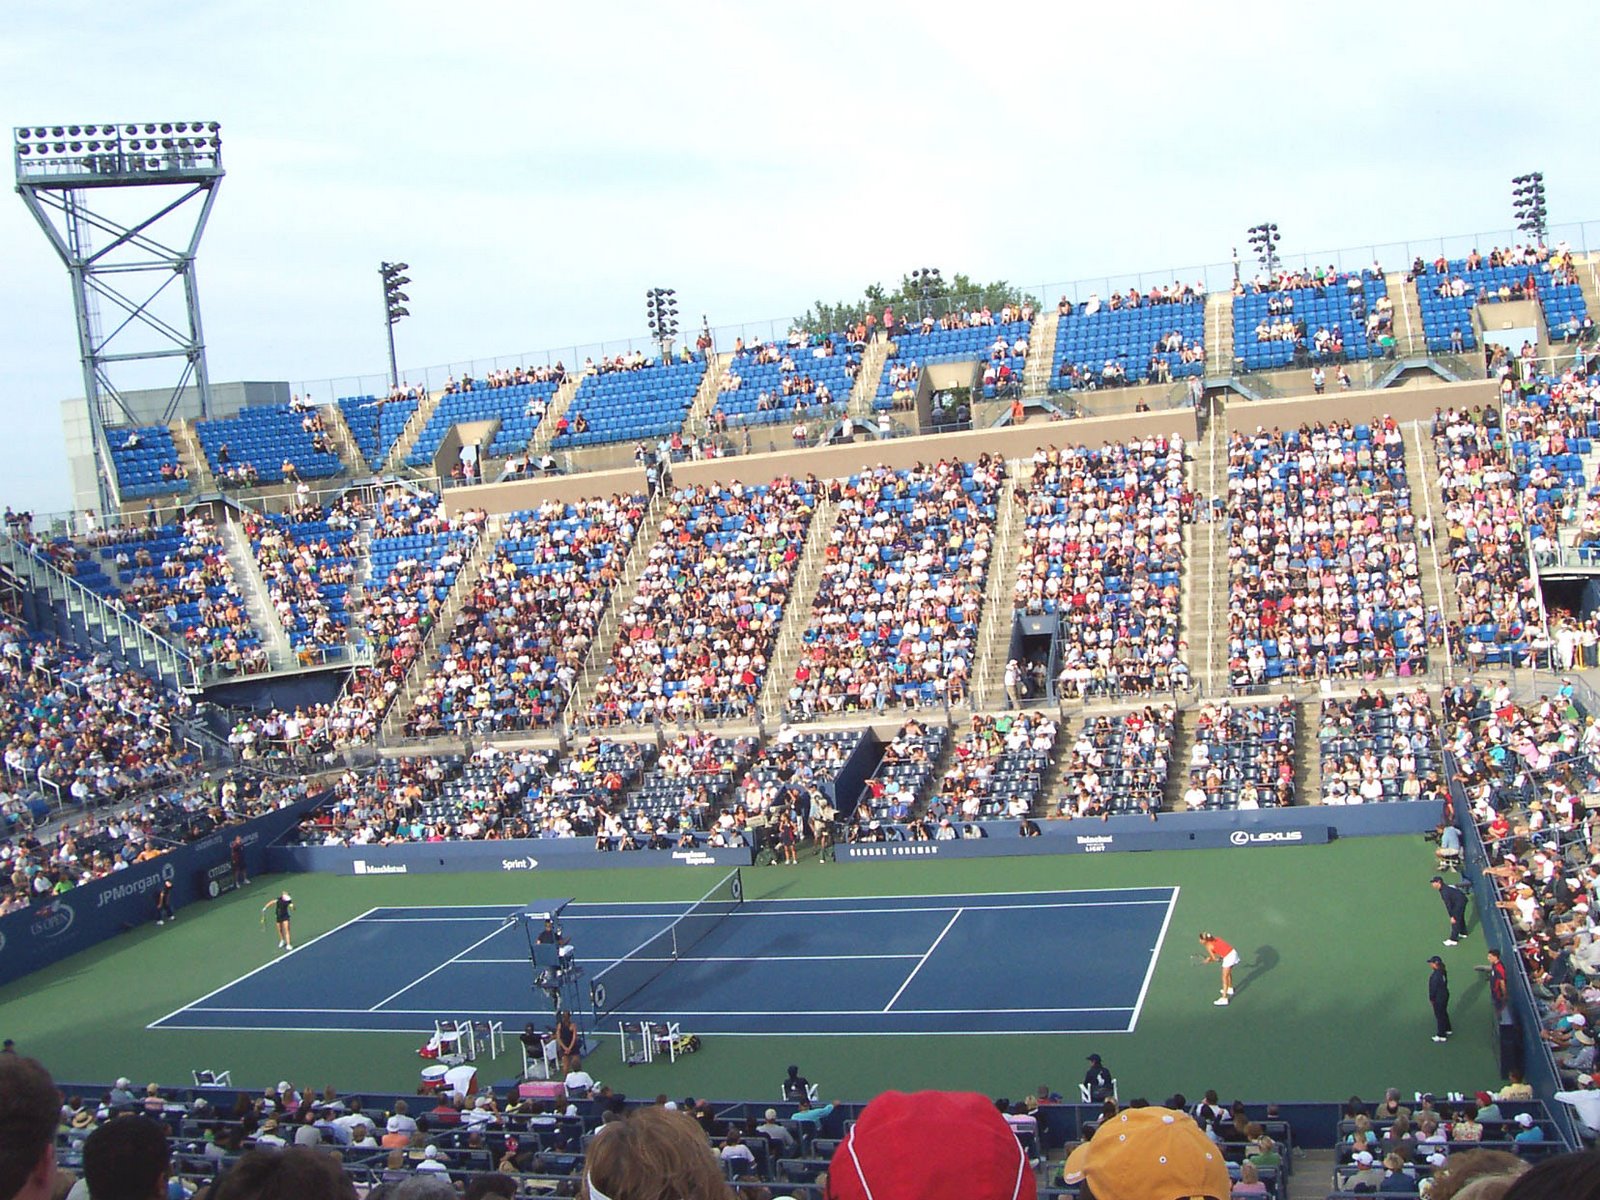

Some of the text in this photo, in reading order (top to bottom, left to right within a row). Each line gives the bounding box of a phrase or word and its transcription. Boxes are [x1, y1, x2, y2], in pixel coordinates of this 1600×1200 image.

[1250, 832, 1302, 841] LEXUS
[850, 846, 937, 856] GEORGE FOREMAN
[502, 860, 528, 870] Sprint
[98, 873, 160, 907] JPMorgan
